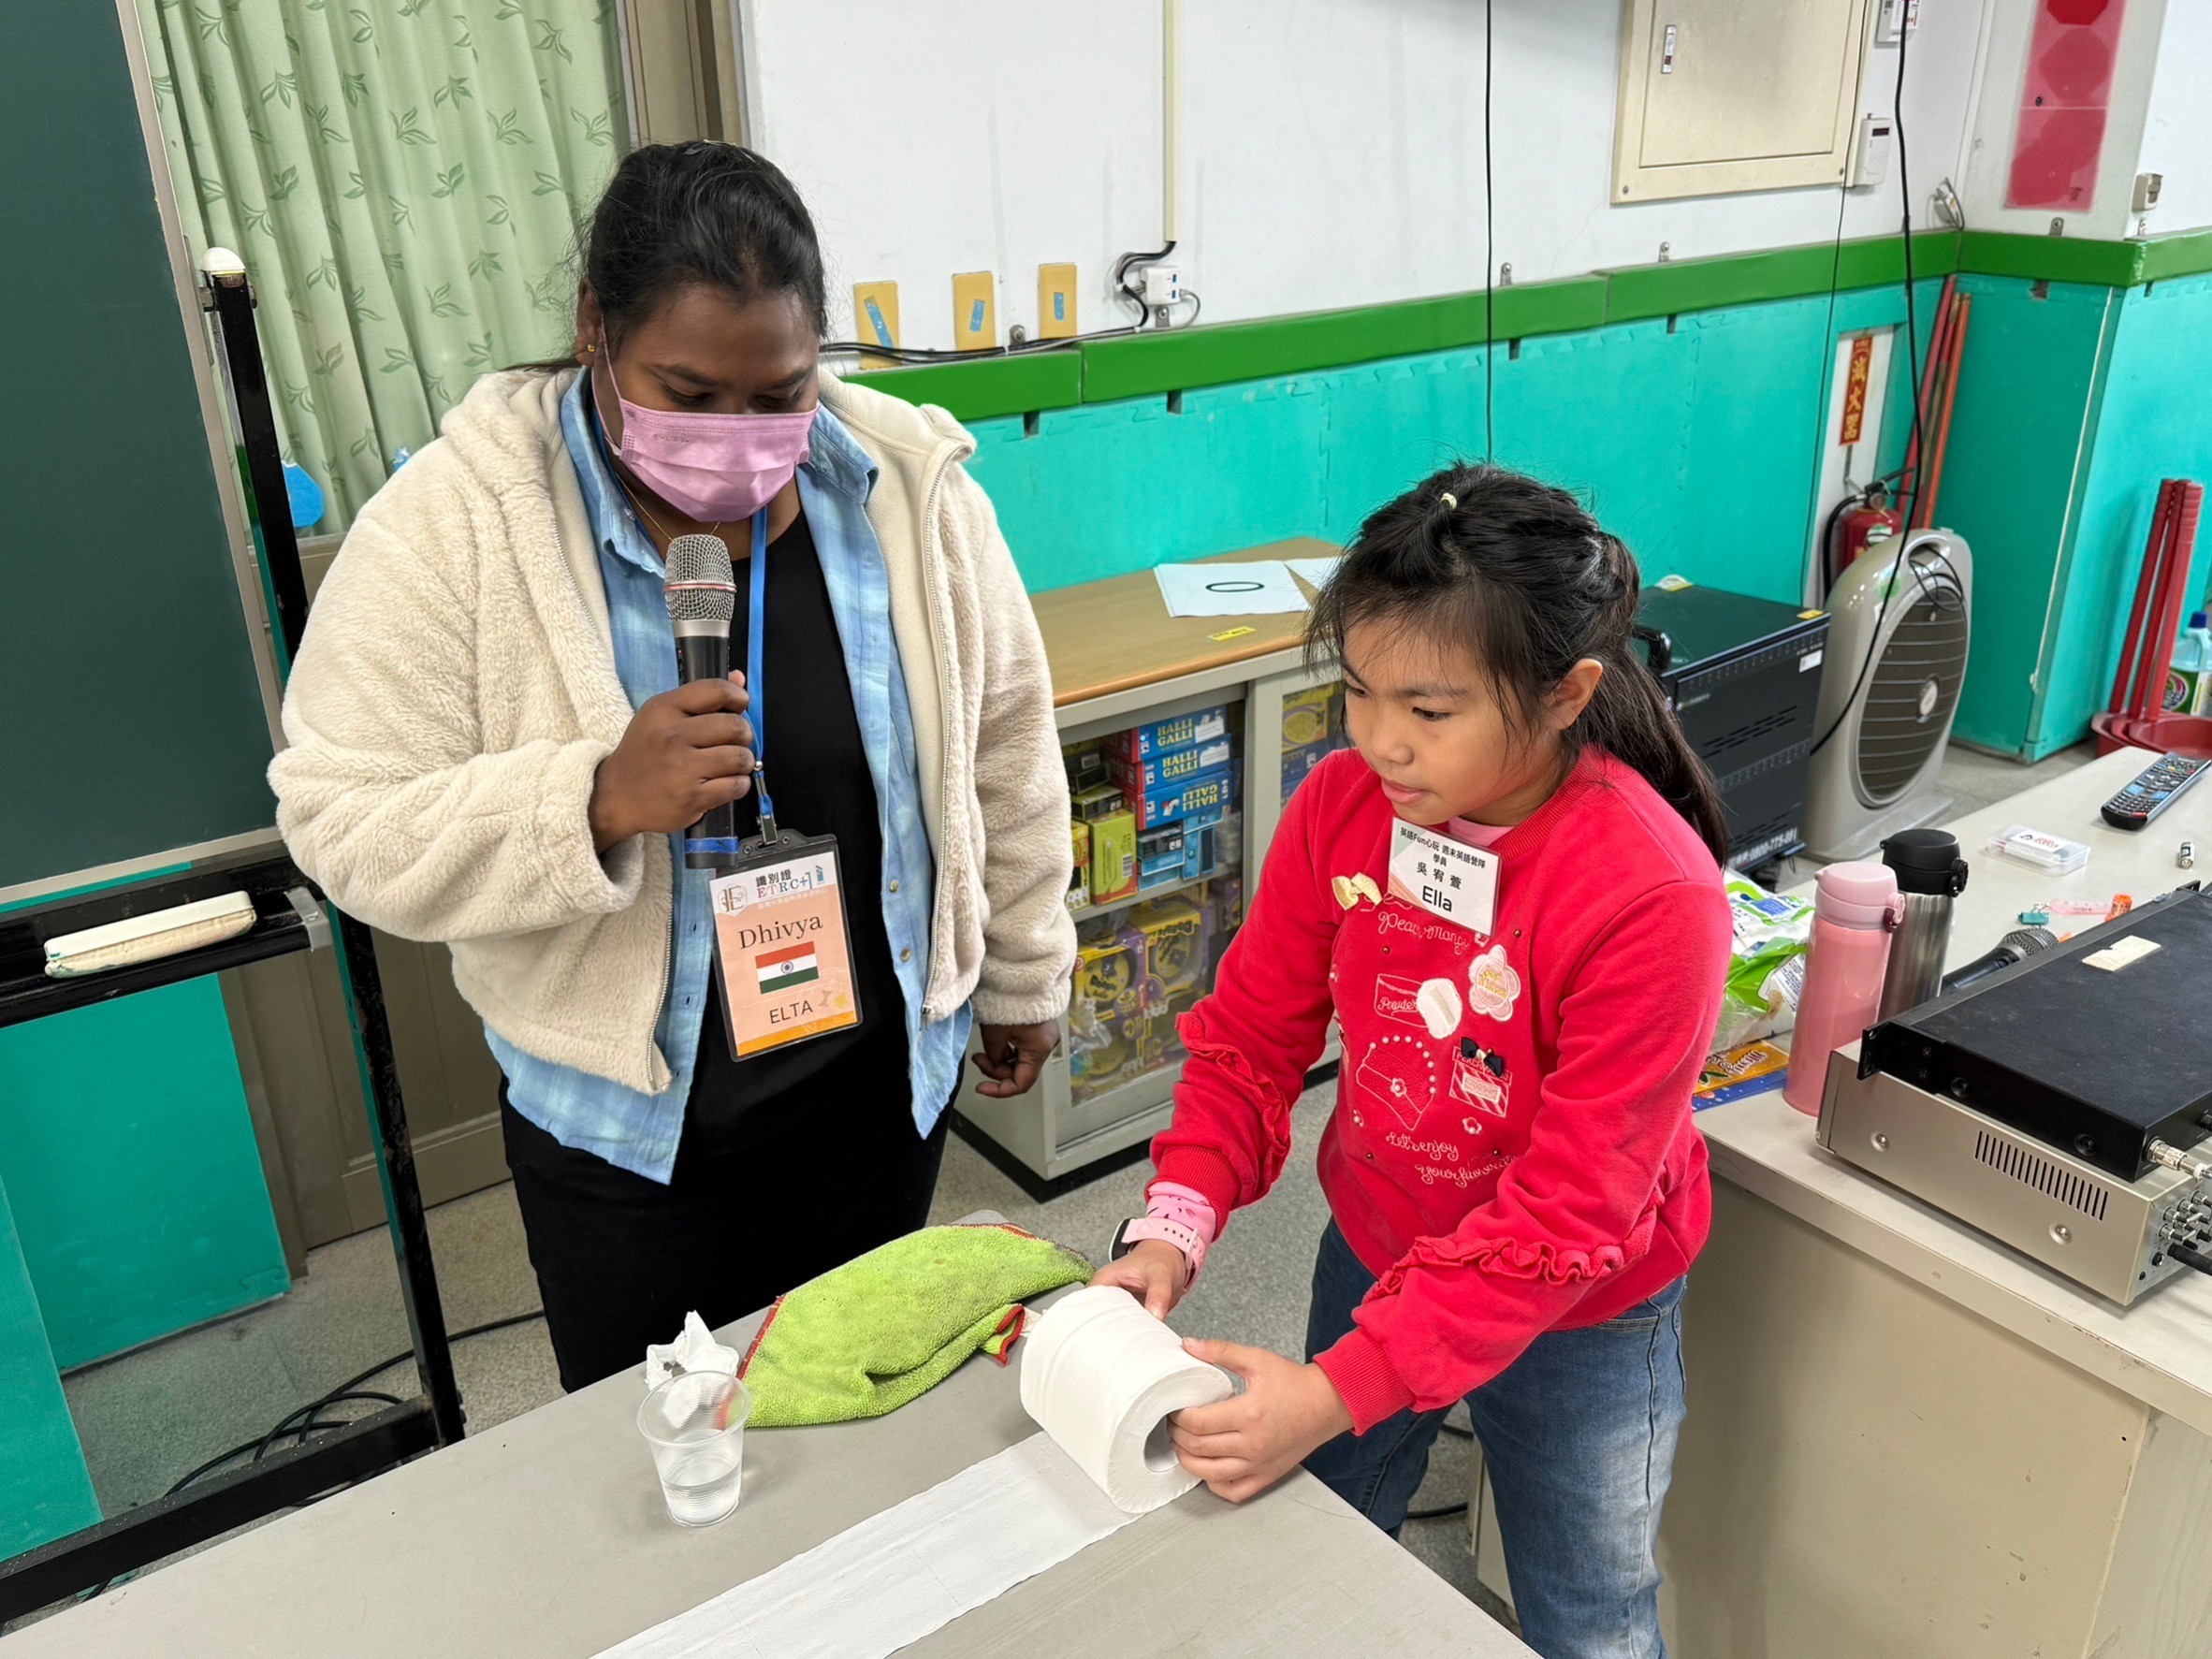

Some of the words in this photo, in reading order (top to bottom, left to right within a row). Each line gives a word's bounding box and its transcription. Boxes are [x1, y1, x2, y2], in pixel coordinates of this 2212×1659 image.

[1157, 719, 1194, 736] HALLI
[1157, 728, 1194, 748] GALLI
[1162, 749, 1199, 768] HALLI
[1162, 760, 1199, 779] GALLI
[1182, 784, 1218, 802] GALLI
[1182, 793, 1218, 812] HALLI
[756, 869, 792, 887] 識別證
[1422, 885, 1452, 912] Ella
[738, 915, 823, 950] Dhivya
[769, 1000, 813, 1024] ELTA
